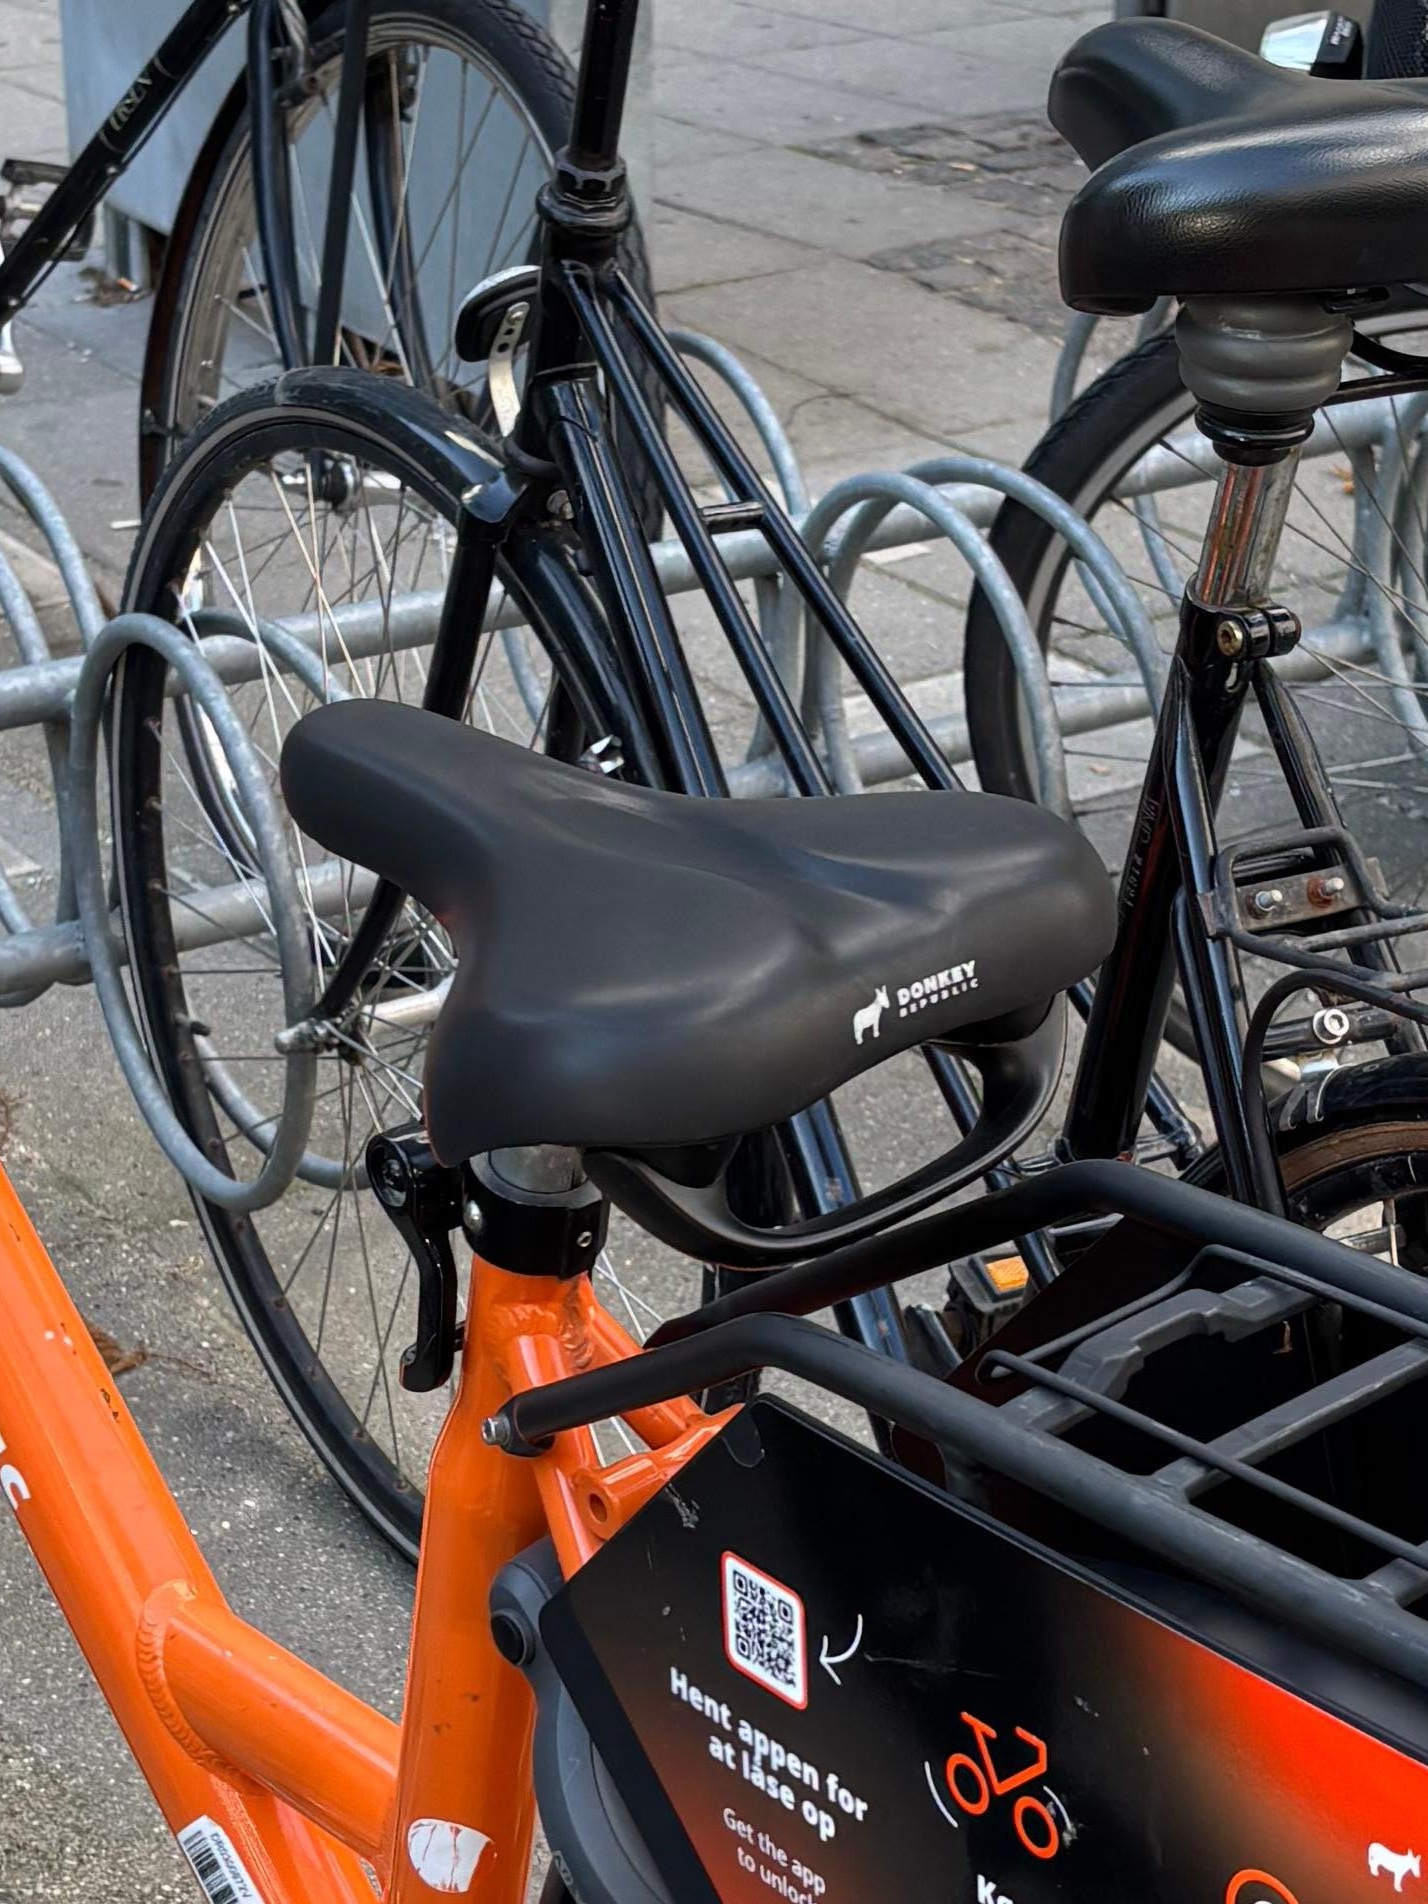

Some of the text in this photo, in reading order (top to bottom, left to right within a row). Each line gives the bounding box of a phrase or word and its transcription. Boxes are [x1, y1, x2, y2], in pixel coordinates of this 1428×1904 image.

[896, 959, 976, 1007] DONKEY
[899, 977, 980, 1018] REPUBLIC
[670, 1666, 868, 1822] Hent appen for
[708, 1735, 835, 1842] at låse op
[723, 1807, 826, 1896] Get the app
[736, 1846, 756, 1873] to
